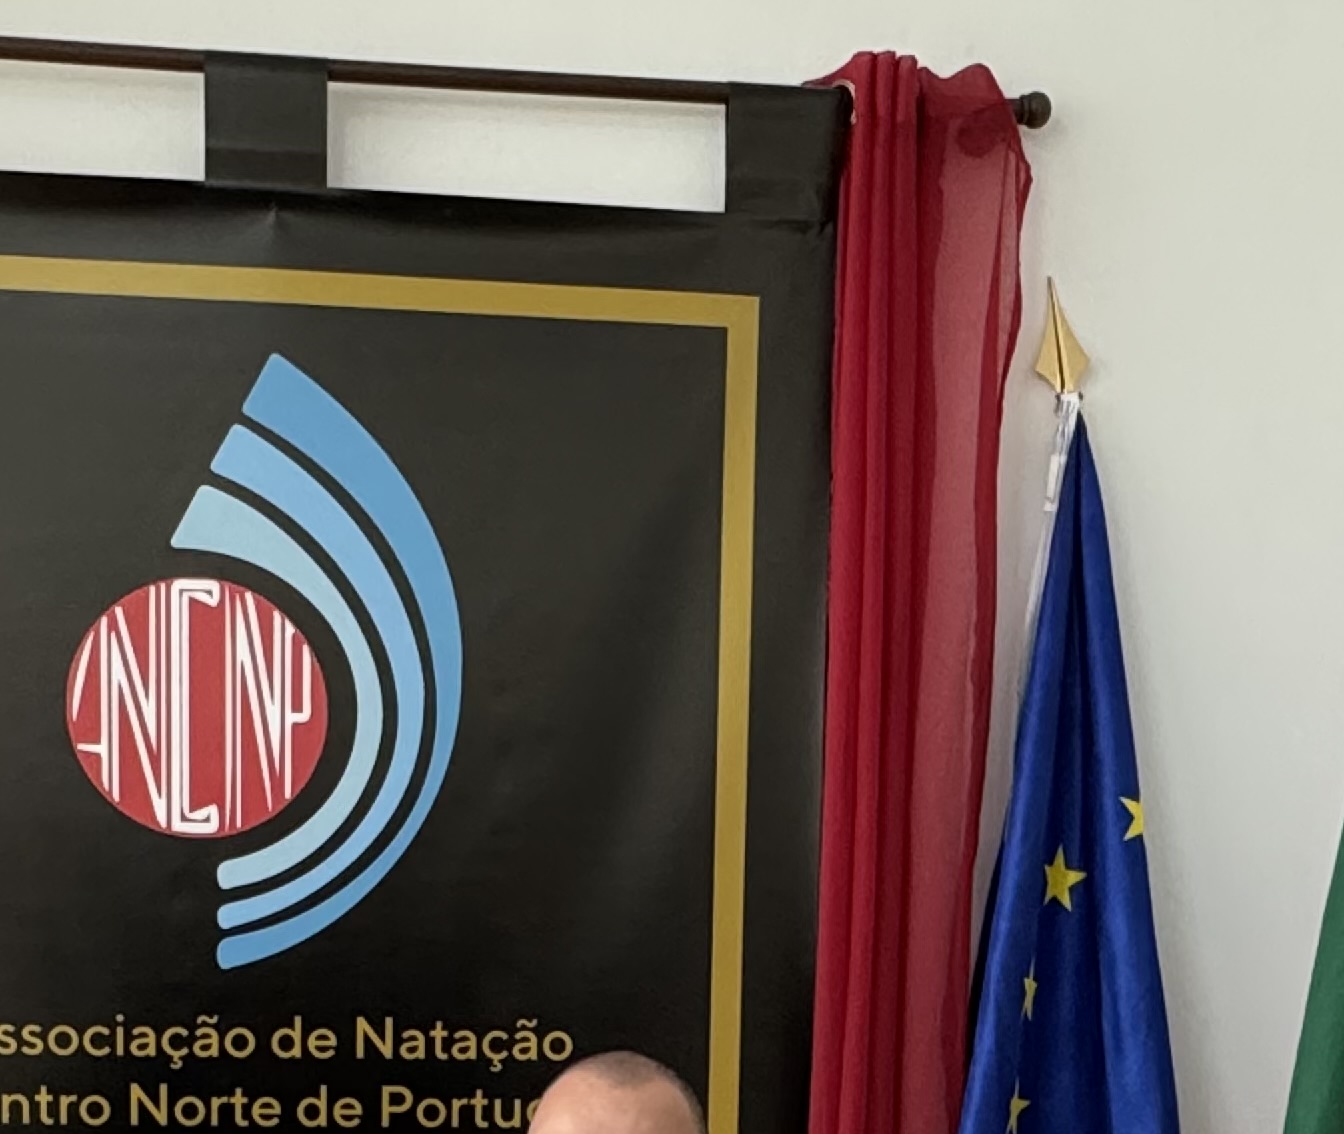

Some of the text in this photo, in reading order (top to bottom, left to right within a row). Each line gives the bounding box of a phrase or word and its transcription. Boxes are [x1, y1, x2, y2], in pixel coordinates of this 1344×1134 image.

[271, 1015, 338, 1060] de
[356, 1016, 574, 1073] Natação
[130, 1082, 282, 1128] Norte
[296, 1084, 363, 1128] de
[381, 1085, 542, 1129] Portu
